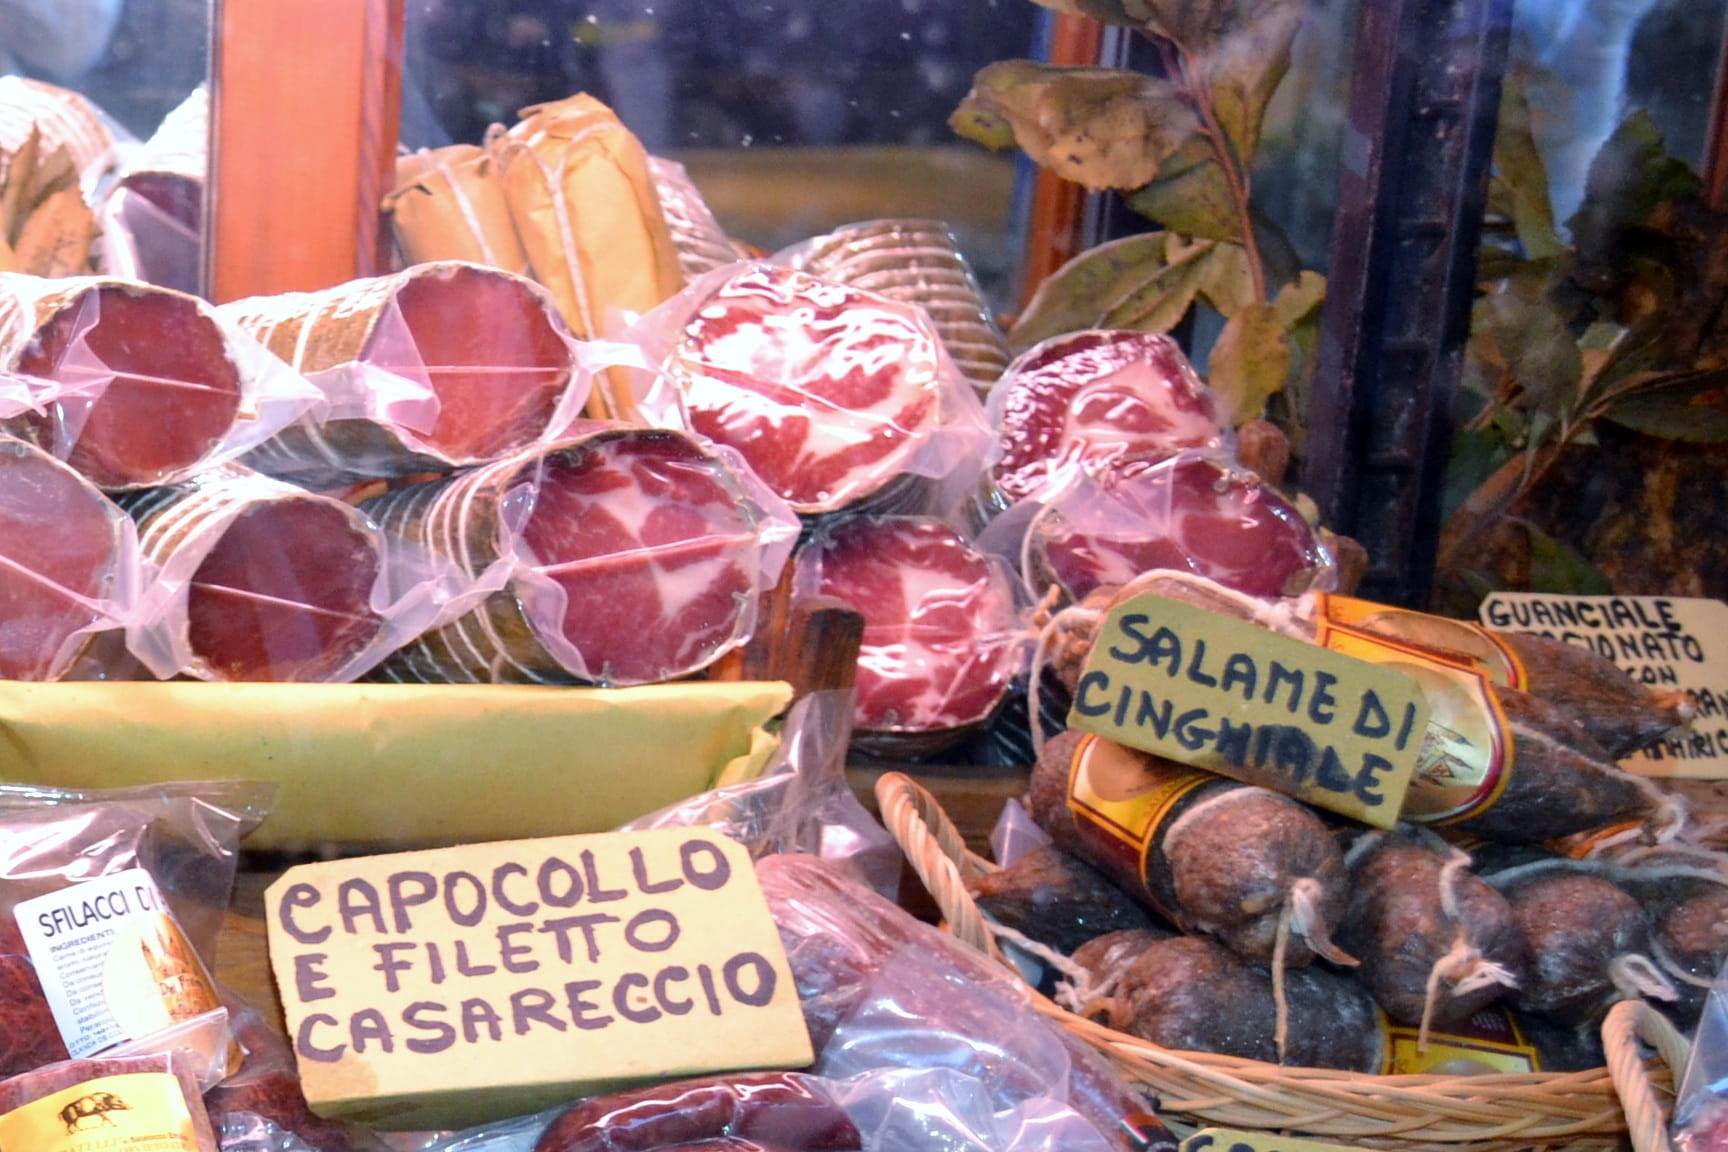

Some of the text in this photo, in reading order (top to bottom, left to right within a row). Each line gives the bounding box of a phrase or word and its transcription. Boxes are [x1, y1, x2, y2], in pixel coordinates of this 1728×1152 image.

[1488, 598, 1682, 631] GUANCIALE
[1109, 613, 1416, 751] SALAME DI
[1074, 671, 1396, 806] CINGHIALE
[39, 889, 131, 937] SFILACCI
[279, 839, 731, 944] CAPOCOLLO
[294, 909, 680, 1002] E FILETTO
[297, 952, 776, 1063] CASARECCIO
